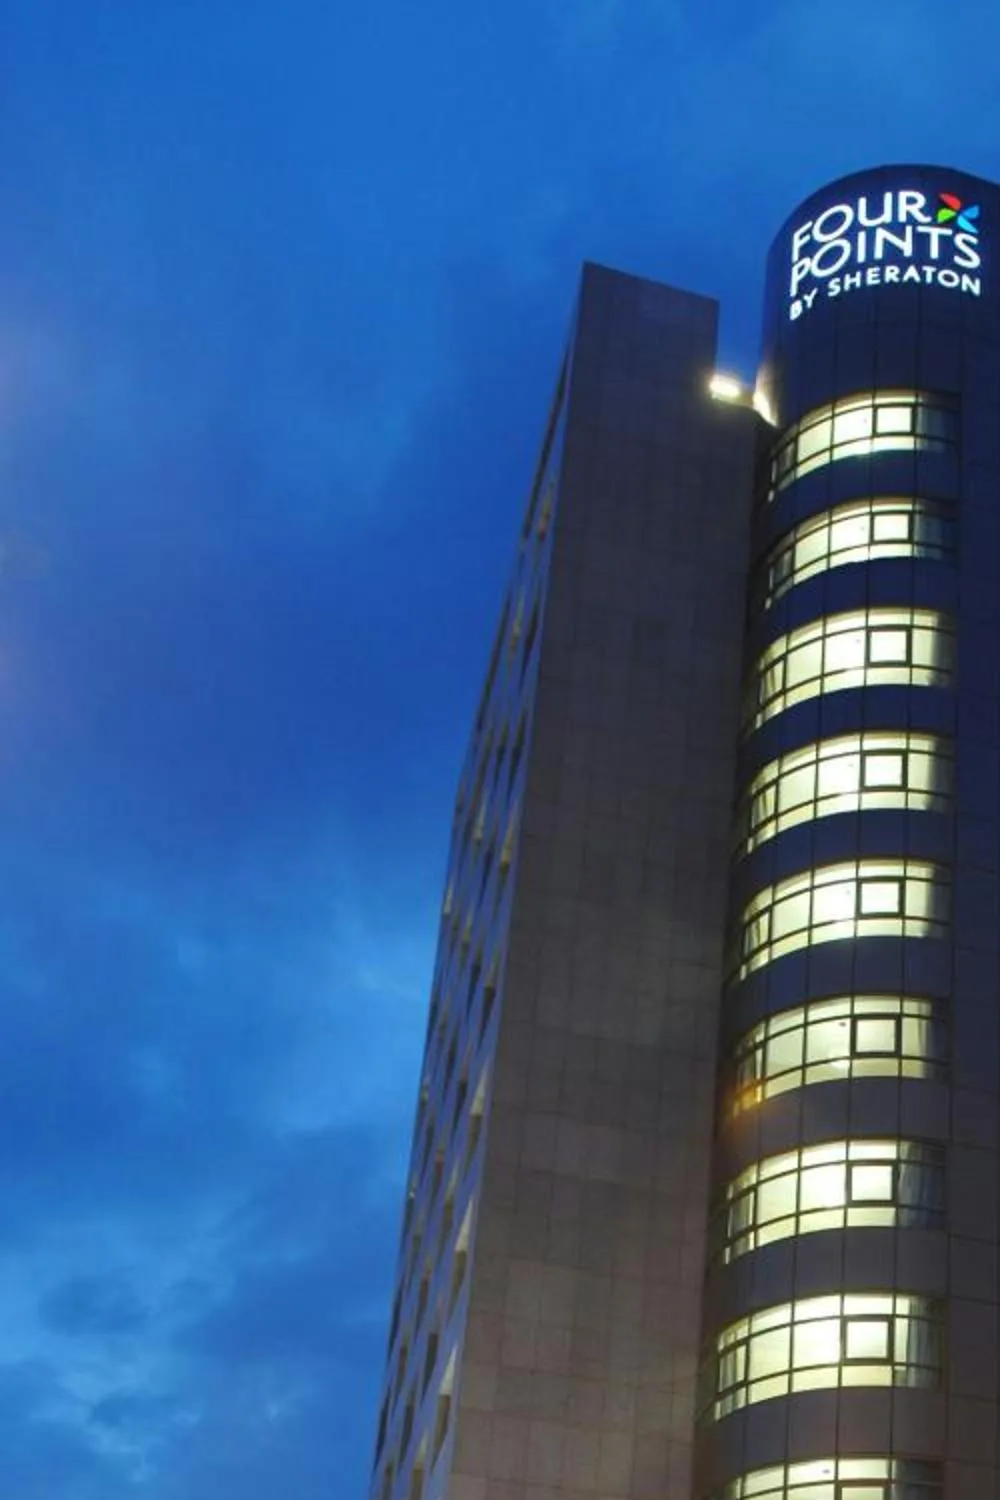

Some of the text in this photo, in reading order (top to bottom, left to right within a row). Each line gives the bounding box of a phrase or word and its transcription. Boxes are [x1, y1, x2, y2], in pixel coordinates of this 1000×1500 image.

[789, 225, 981, 297] POINTS
[791, 190, 932, 262] FOUR
[789, 265, 981, 321] BY SHERATON
